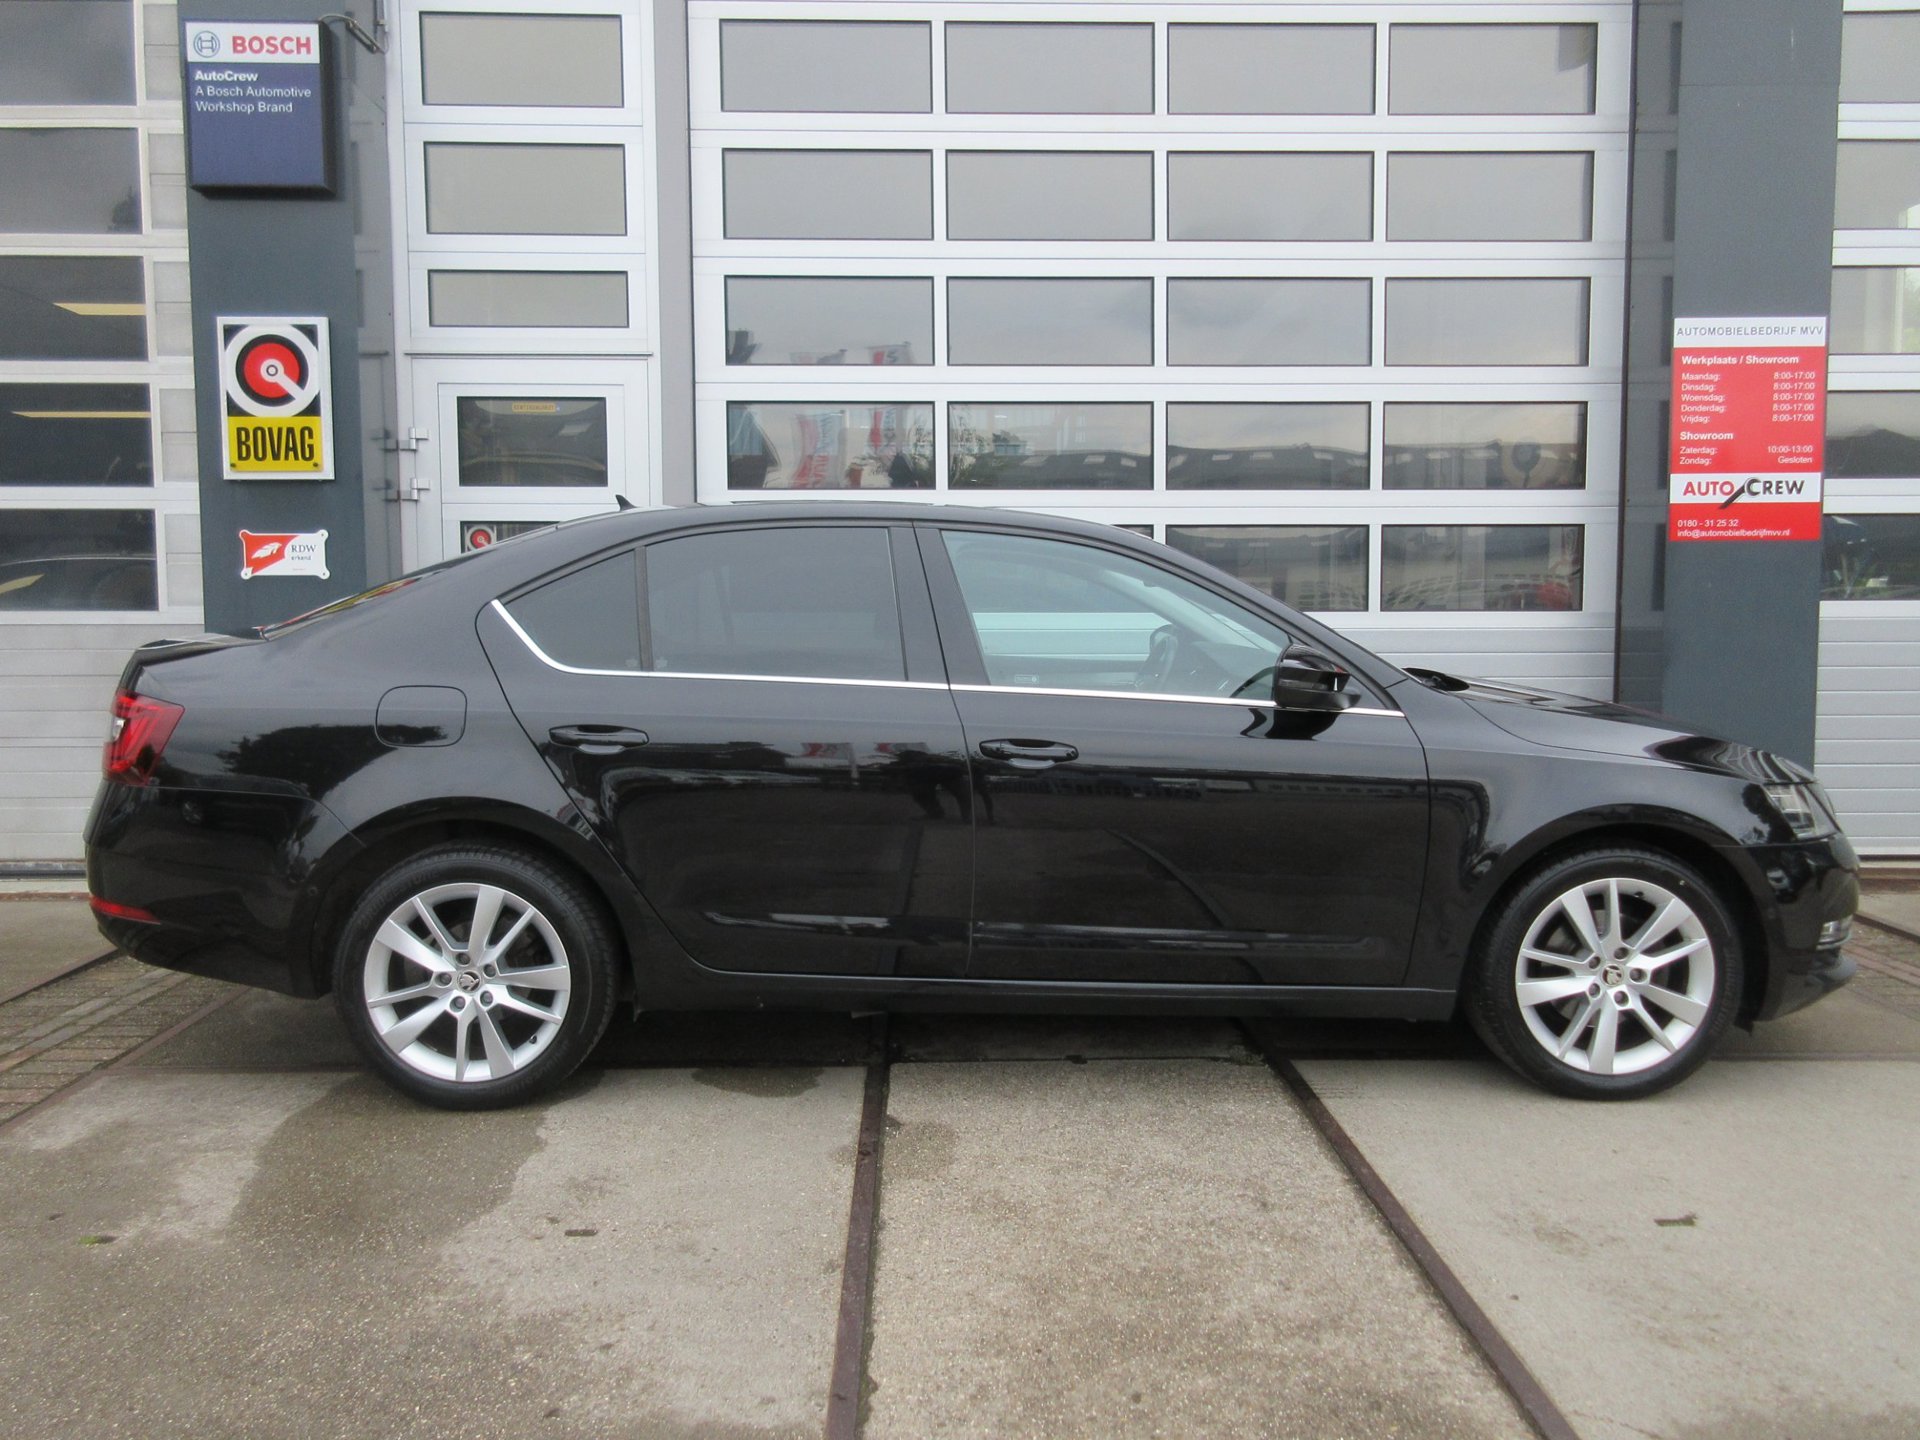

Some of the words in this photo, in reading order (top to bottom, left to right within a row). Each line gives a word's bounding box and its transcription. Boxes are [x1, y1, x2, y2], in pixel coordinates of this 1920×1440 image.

[231, 35, 312, 55] BOSCH
[194, 70, 259, 82] AutoCrew
[195, 86, 204, 97] A
[207, 86, 243, 97] Bosch
[246, 86, 312, 98] Automotive
[195, 101, 255, 114] Workshop
[258, 101, 293, 113] Brand
[1676, 326, 1797, 337] AUTOMOBIELBEDRIJF
[1799, 326, 1824, 335] MVV
[1681, 355, 1737, 366] Werkplaats
[1745, 355, 1800, 365] Showroom
[1681, 372, 1721, 382] Maandag:
[1773, 371, 1816, 380] 8:00-17:00
[1681, 383, 1716, 392] Dinsdag:
[1773, 382, 1815, 390] 8:00-17:00
[1681, 393, 1726, 403] Woensdag:
[1772, 393, 1815, 401] 8:00-17:00
[1681, 403, 1727, 413] Donderdag:
[1772, 403, 1815, 411] 8:00-17:00
[1680, 414, 1711, 424] Vrijdag:
[1771, 414, 1814, 422] 8:00-17:00
[1679, 431, 1734, 441] Showroom
[236, 426, 315, 462] BOVAG
[1679, 446, 1718, 456] Zaterdag:
[1679, 456, 1712, 466] Zondag:
[1777, 456, 1813, 464] Gesloten
[1677, 519, 1698, 527] 0180
[1704, 519, 1714, 527] 31
[1716, 519, 1727, 527] 25
[1728, 519, 1738, 527] 32
[1677, 529, 1790, 539] info@automobielbedrijfmvv.nl
[291, 544, 317, 553] RDW
